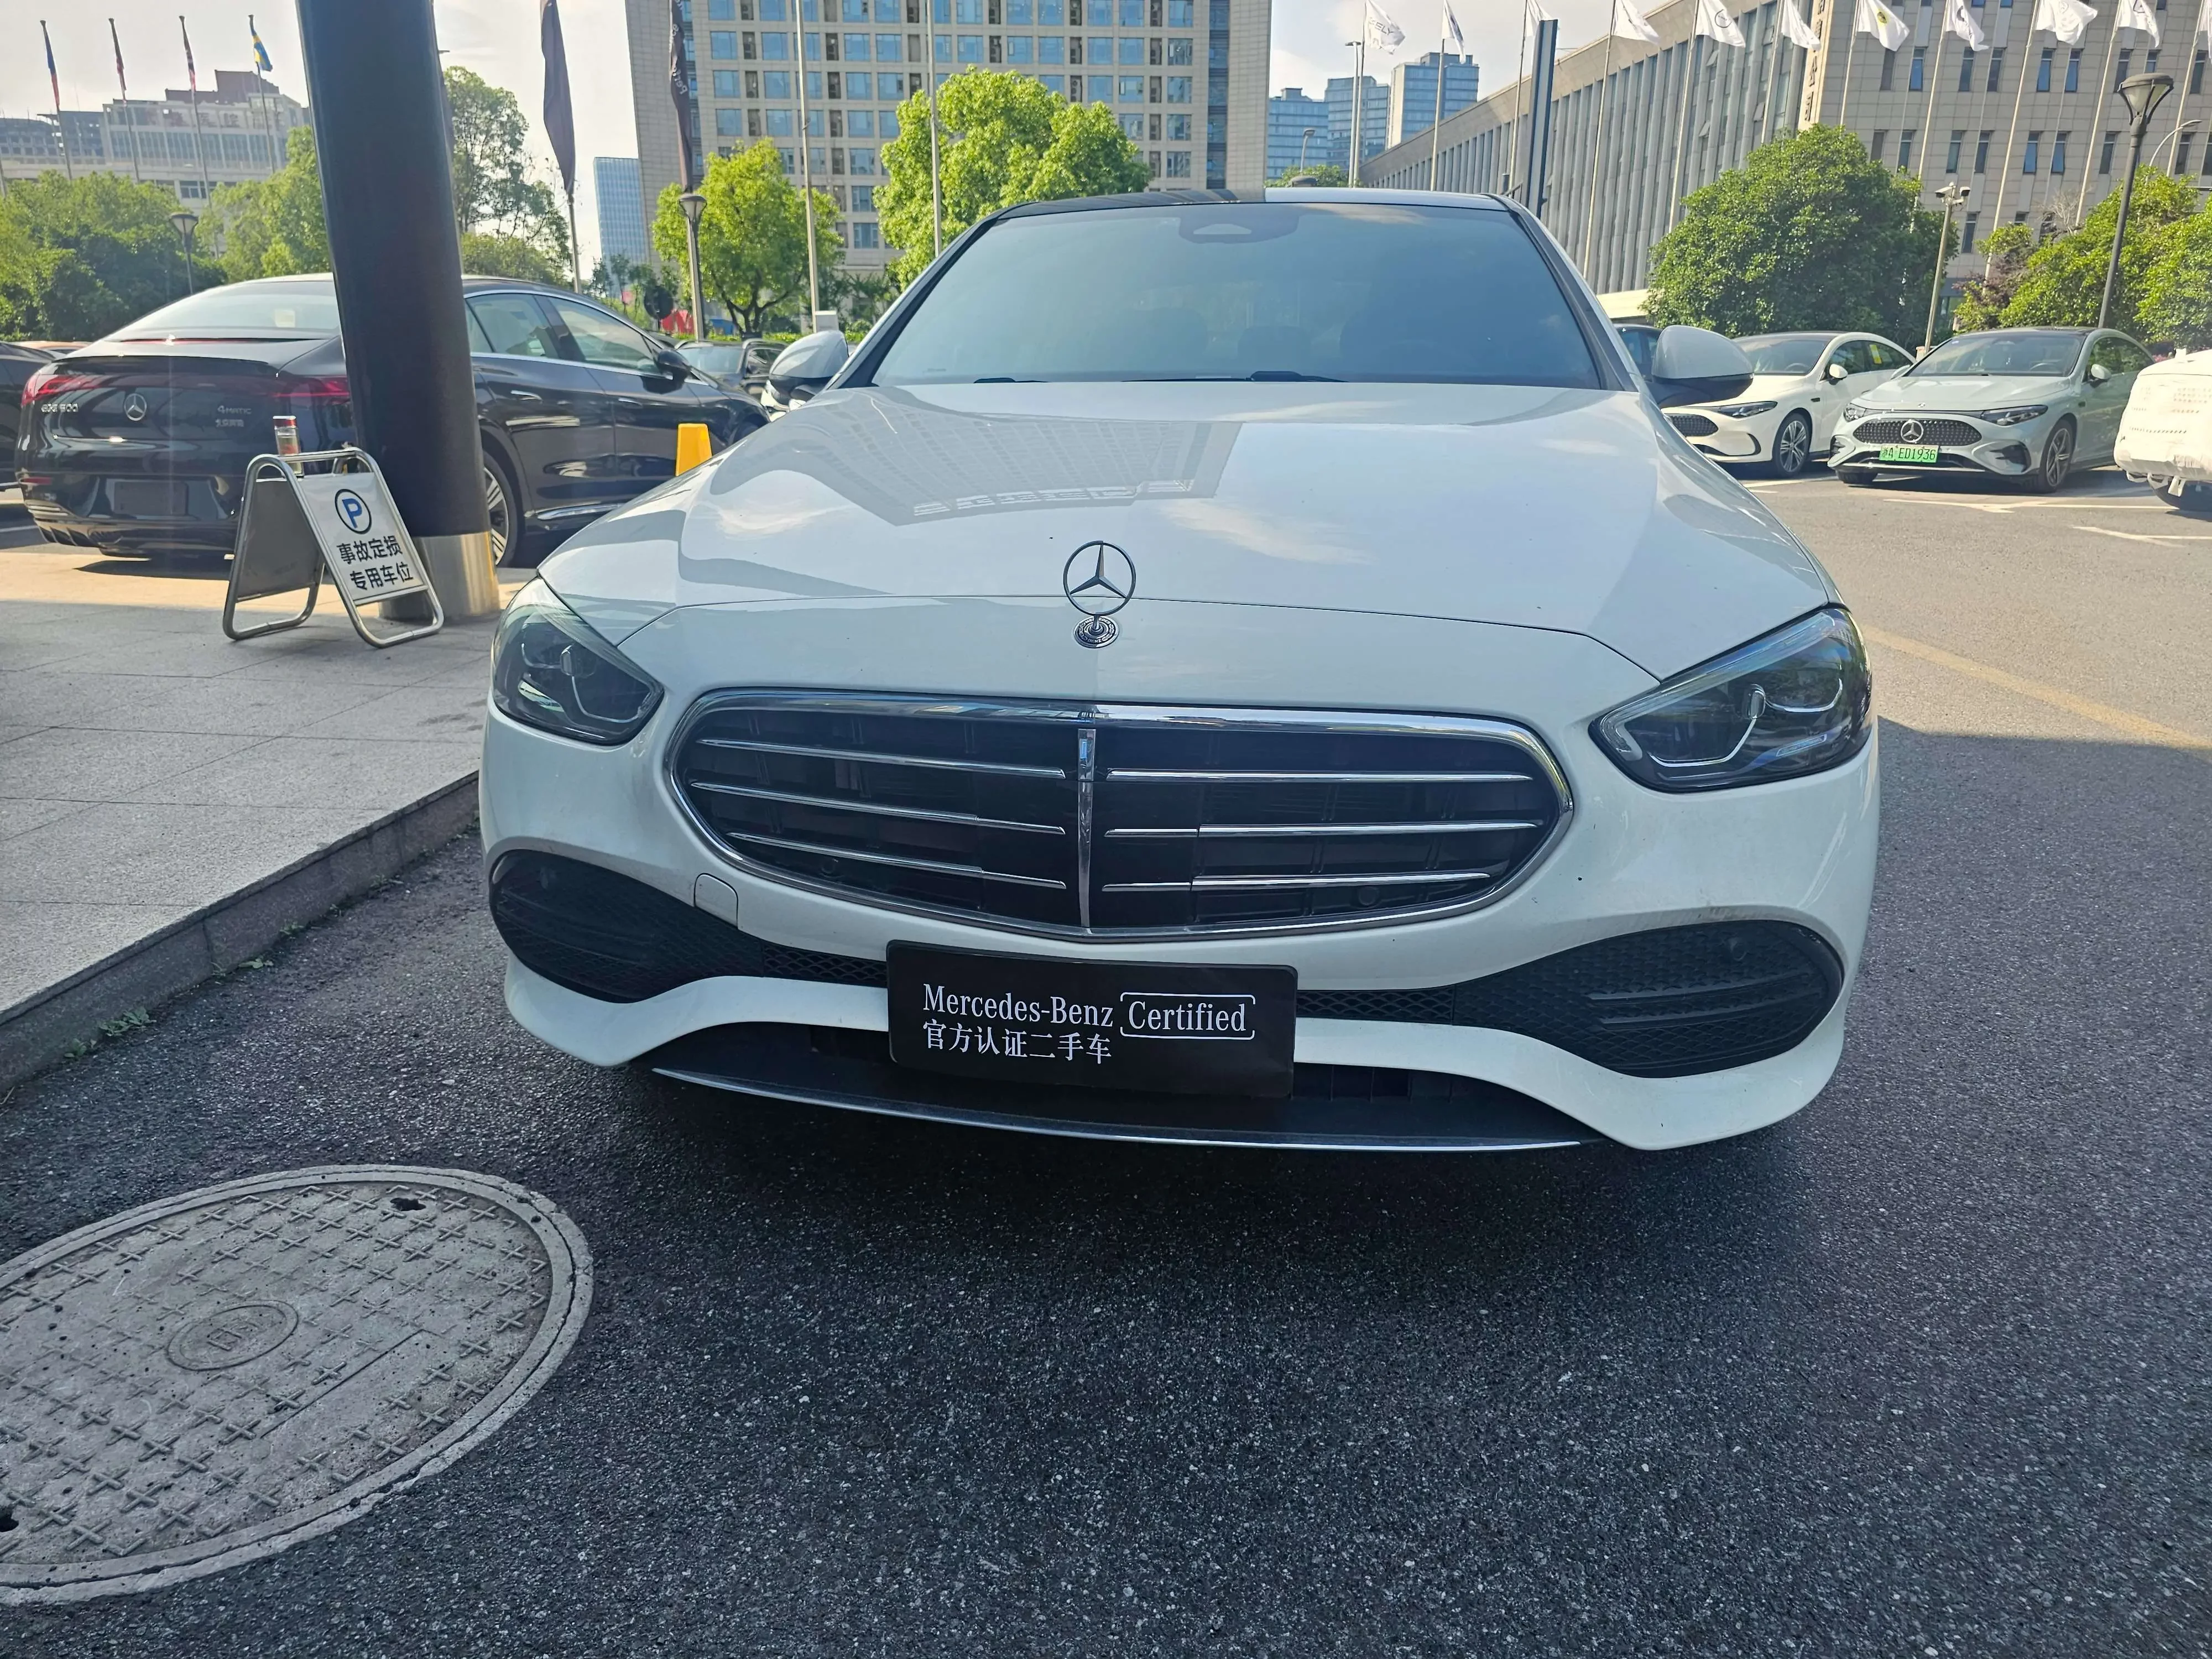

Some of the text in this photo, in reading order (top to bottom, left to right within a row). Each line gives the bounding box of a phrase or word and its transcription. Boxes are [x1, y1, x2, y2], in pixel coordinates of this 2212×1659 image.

[217, 405, 252, 414] 4MATIC
[1898, 447, 1936, 460] ED1936
[342, 498, 362, 528] P
[336, 535, 403, 565] 事故定损
[349, 561, 414, 590] 专用车位
[923, 983, 1246, 1032] Mercedes-Benz Certified
[923, 1019, 1112, 1065] 官方认证二手车
